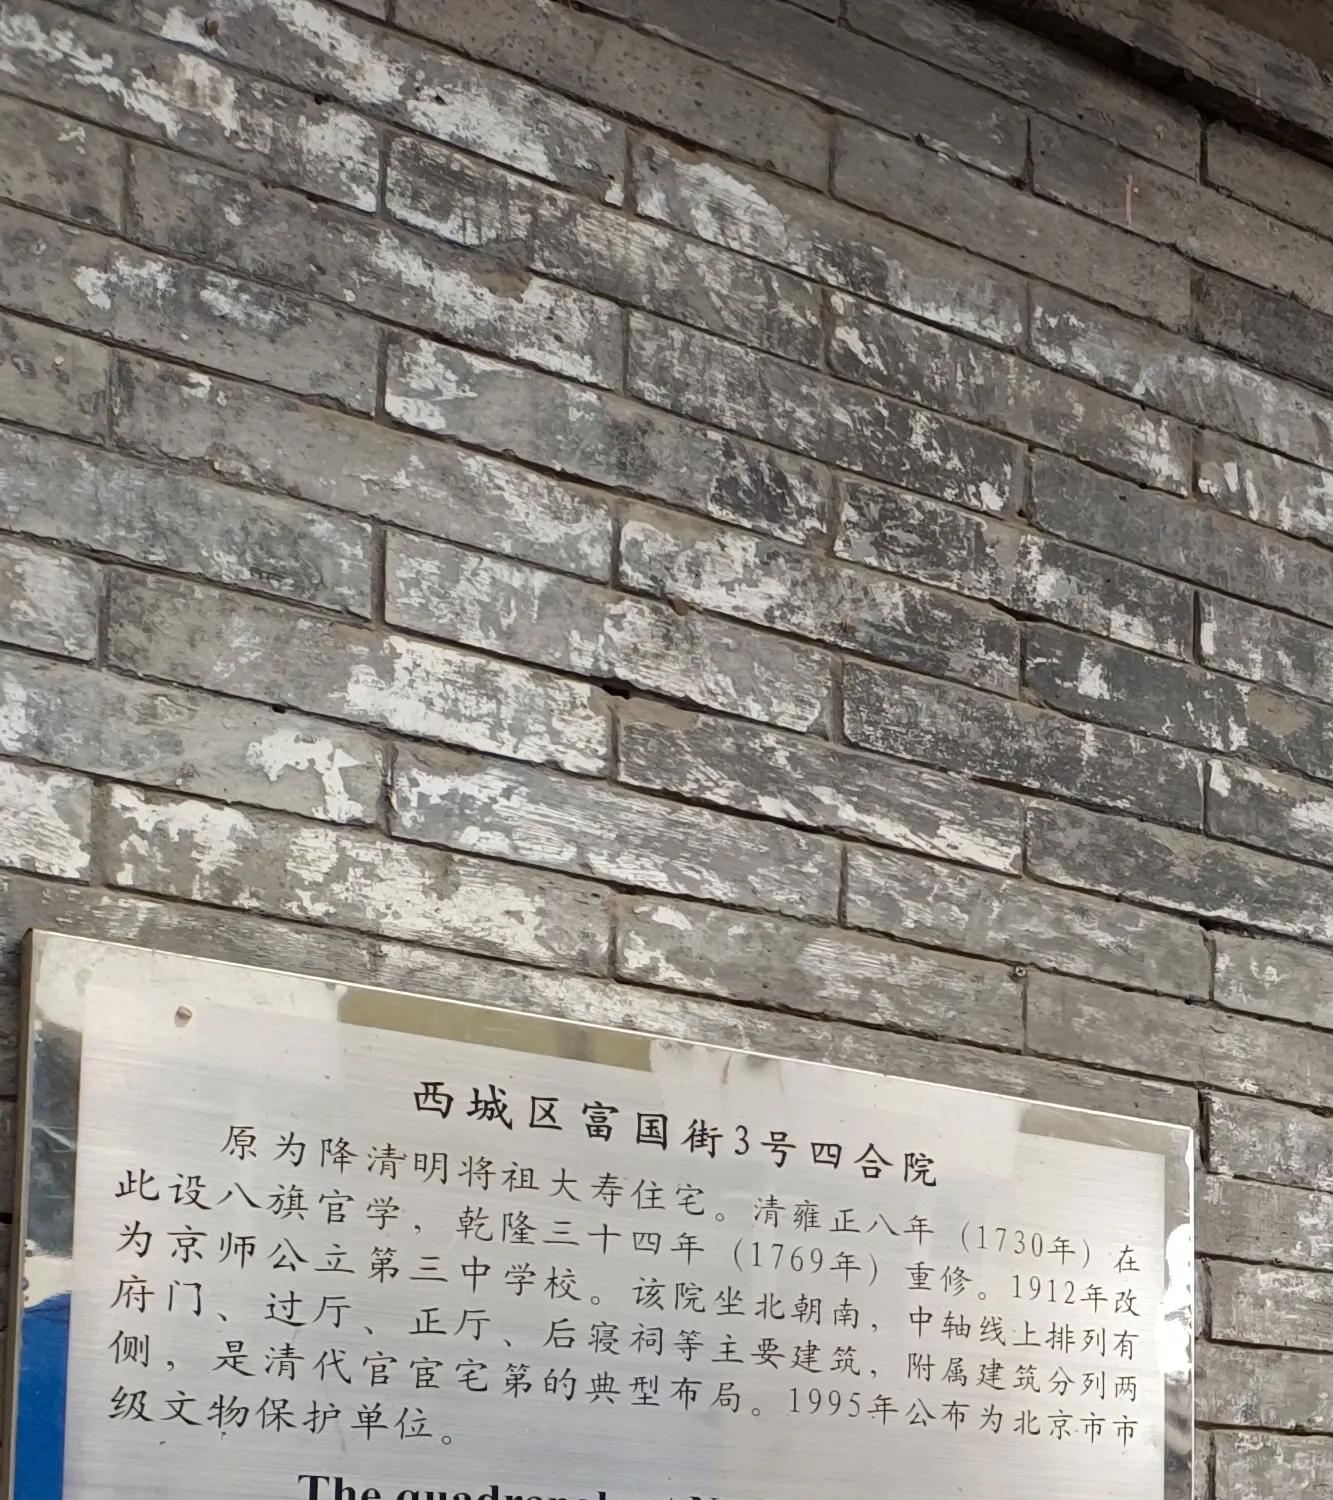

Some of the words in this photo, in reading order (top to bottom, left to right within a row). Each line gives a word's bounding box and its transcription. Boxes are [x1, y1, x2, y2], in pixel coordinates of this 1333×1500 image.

[413, 1081, 937, 1186] 西城区富国街3号四合院
[108, 1384, 453, 1447] 级文物保护单位。
